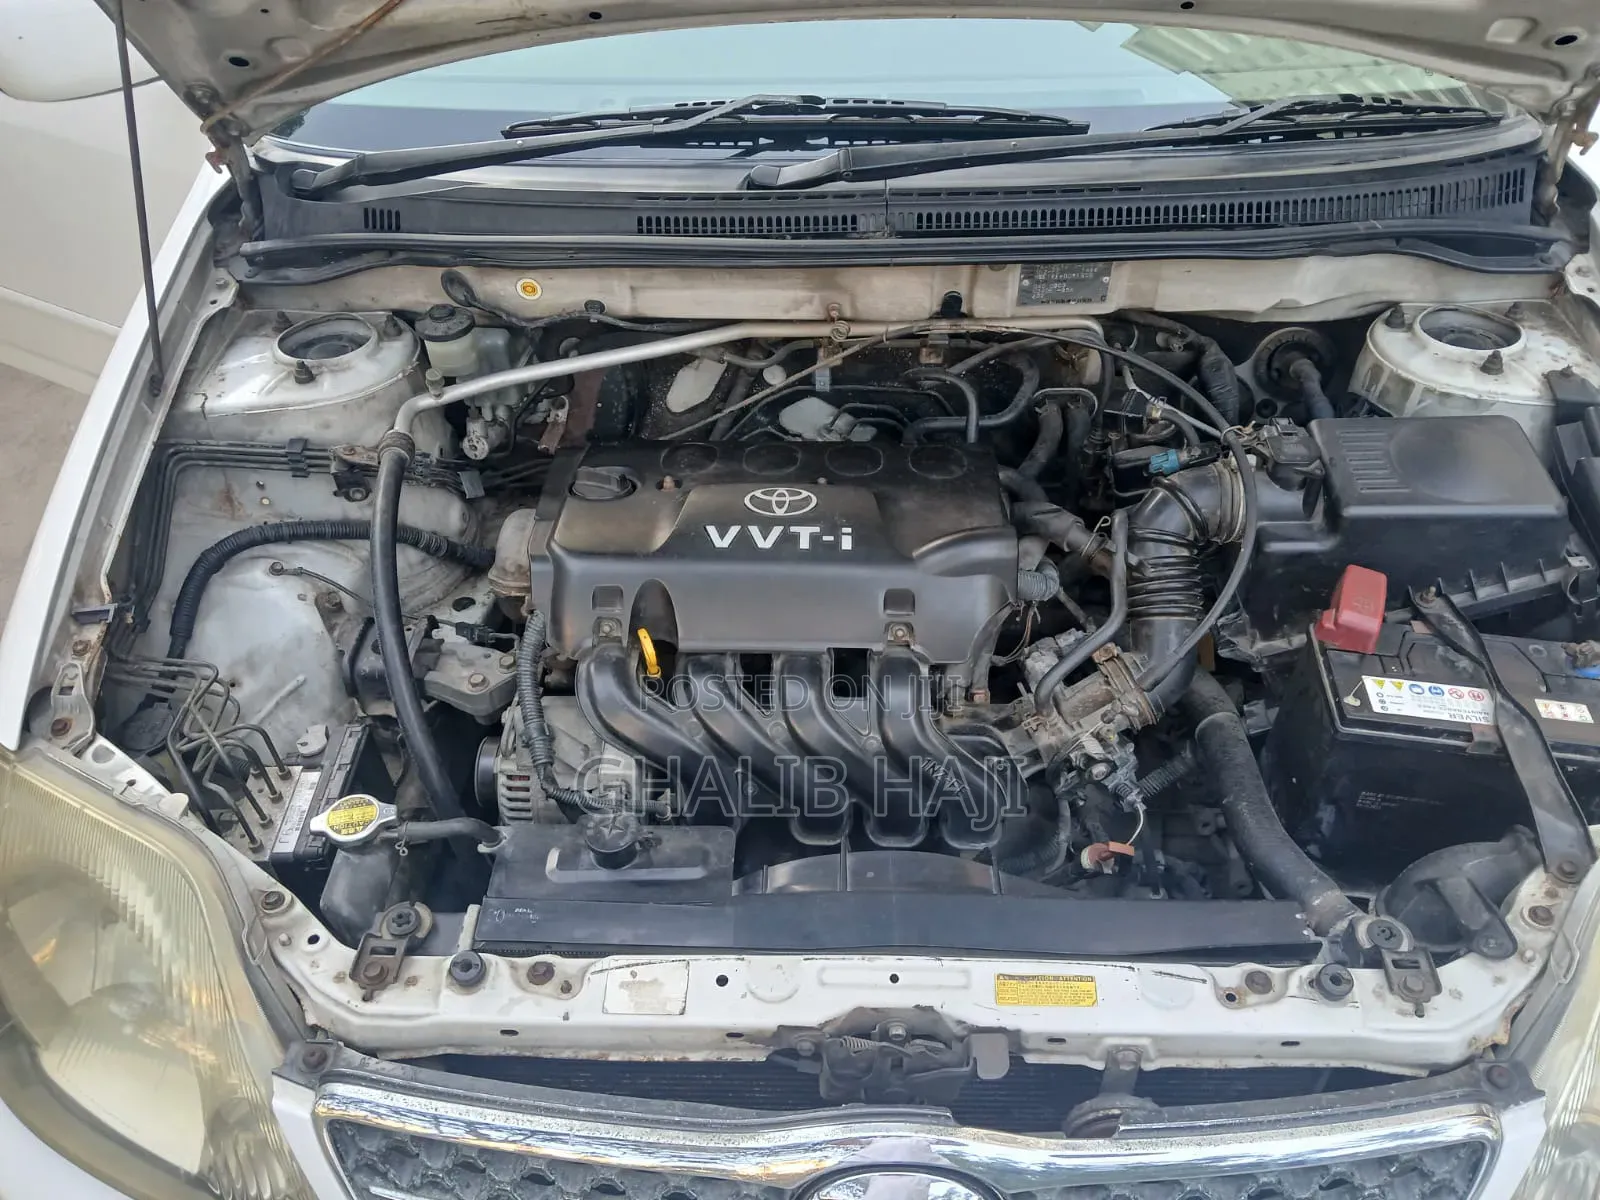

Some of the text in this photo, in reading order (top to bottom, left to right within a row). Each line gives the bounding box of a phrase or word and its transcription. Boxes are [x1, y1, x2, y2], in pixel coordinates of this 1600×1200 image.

[704, 525, 853, 551] VVT-i
[1447, 712, 1490, 723] SILVER
[333, 819, 370, 830] CAUTION
